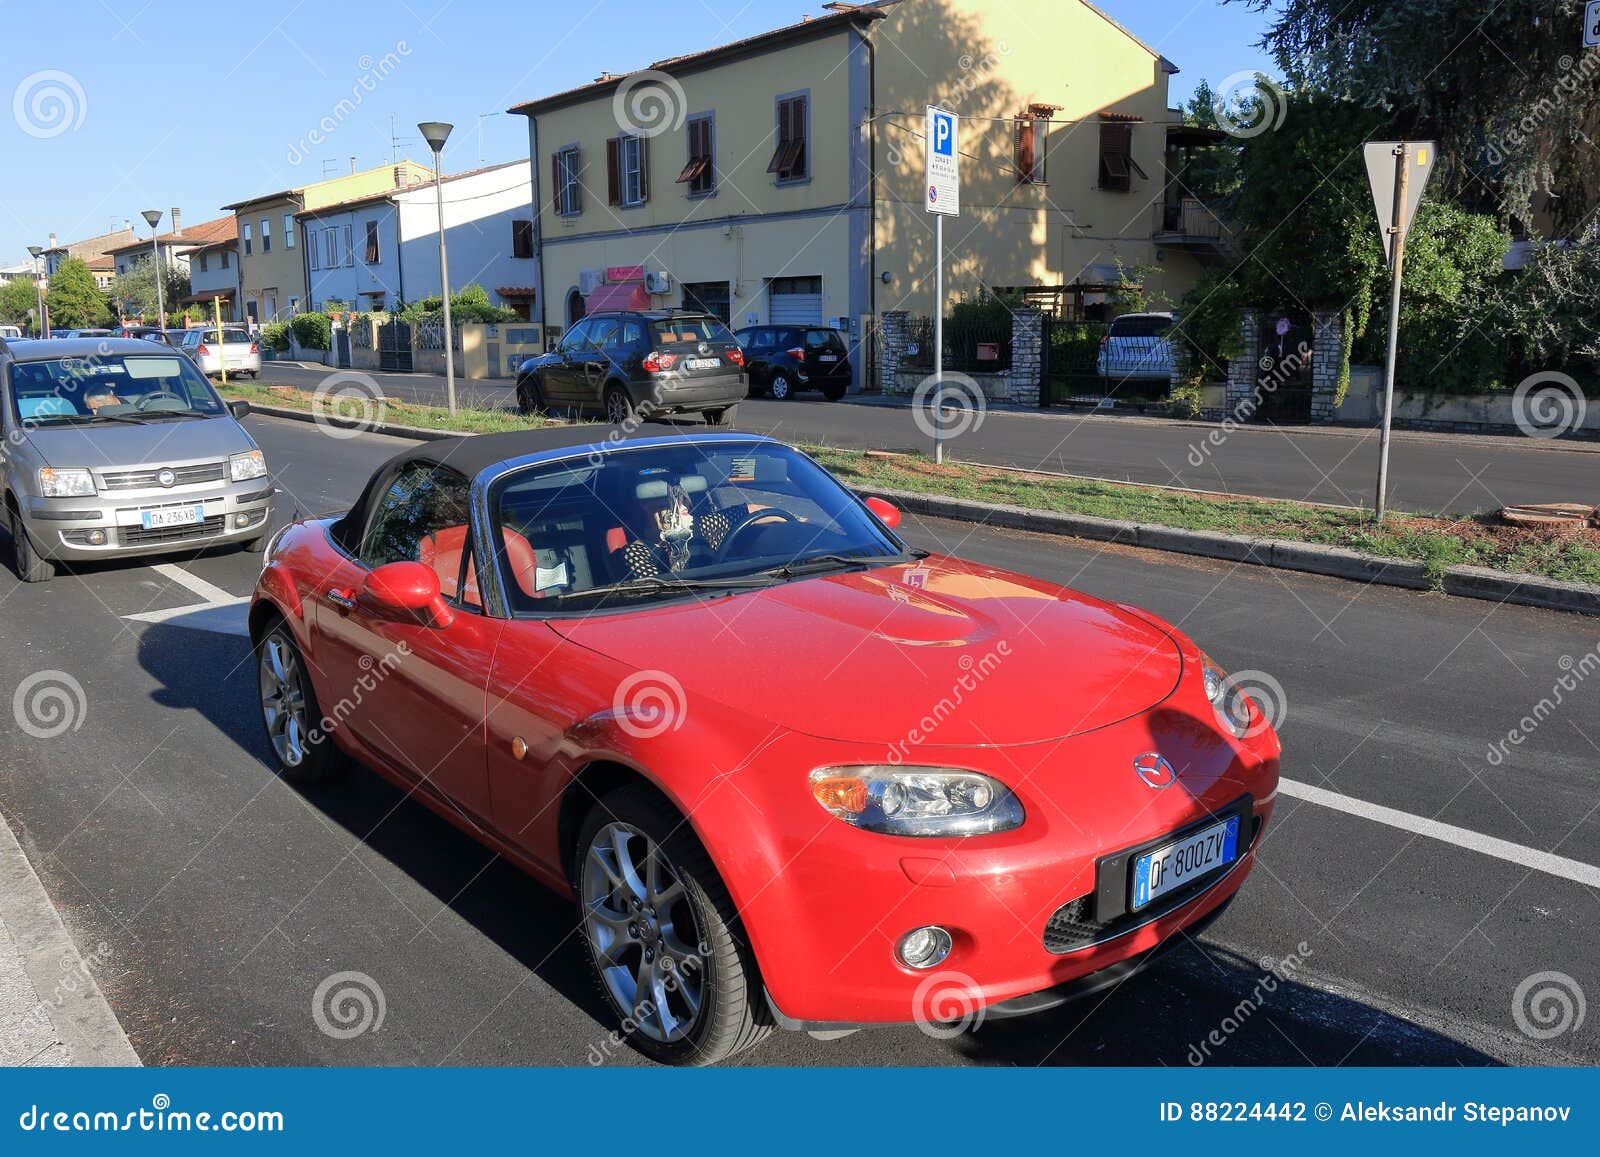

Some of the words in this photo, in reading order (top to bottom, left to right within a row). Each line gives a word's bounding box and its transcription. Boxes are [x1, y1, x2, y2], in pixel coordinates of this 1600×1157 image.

[937, 117, 949, 151] P
[152, 514, 164, 525] DA
[1151, 854, 1172, 890] DF
[1175, 830, 1225, 878] 800ZV
